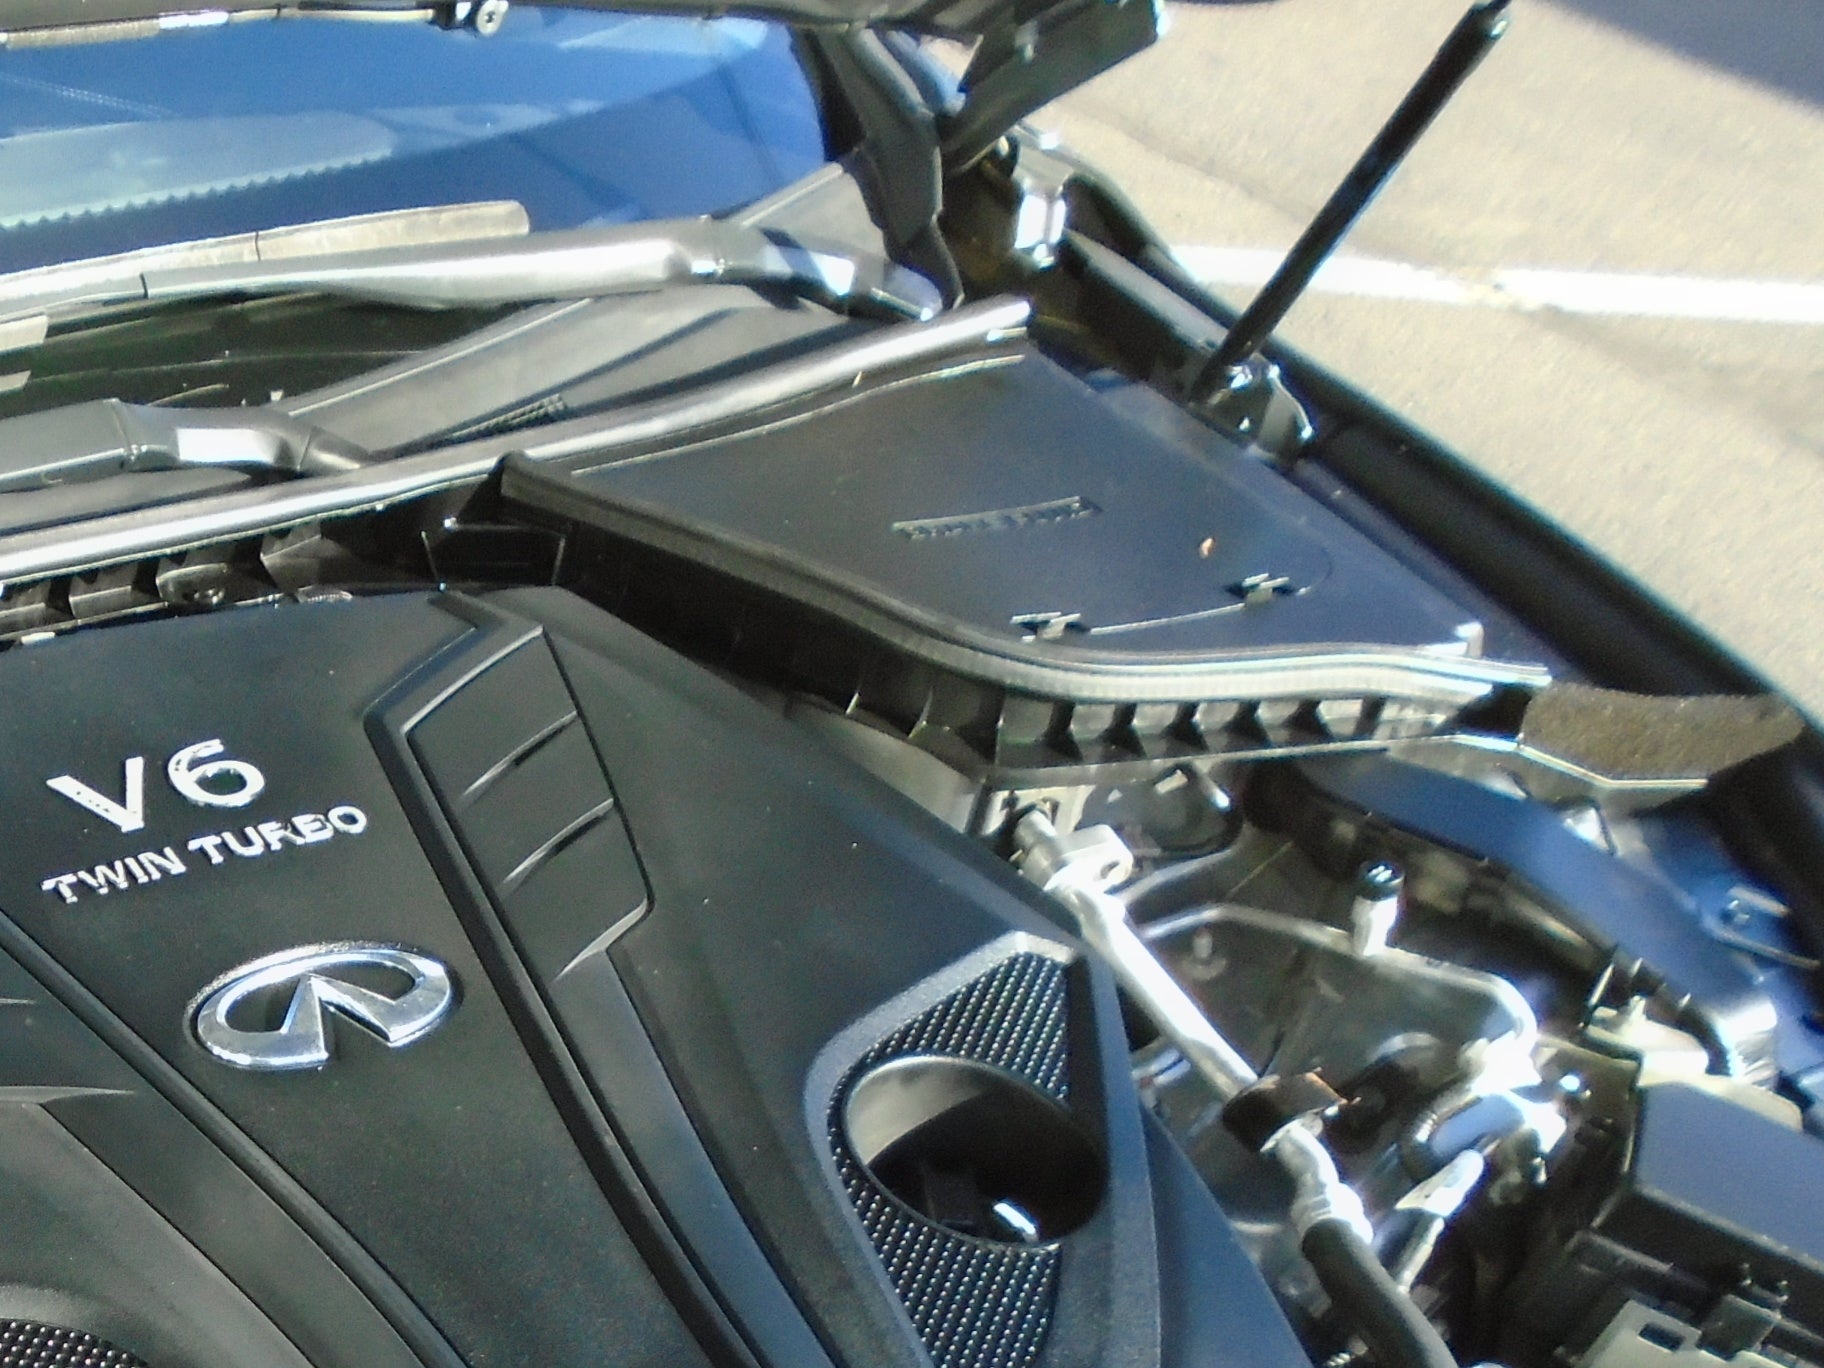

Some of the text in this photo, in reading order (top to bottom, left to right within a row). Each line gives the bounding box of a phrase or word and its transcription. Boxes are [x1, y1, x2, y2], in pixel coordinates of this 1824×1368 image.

[46, 738, 265, 833] V6
[41, 805, 367, 904] TWIN TURBO
